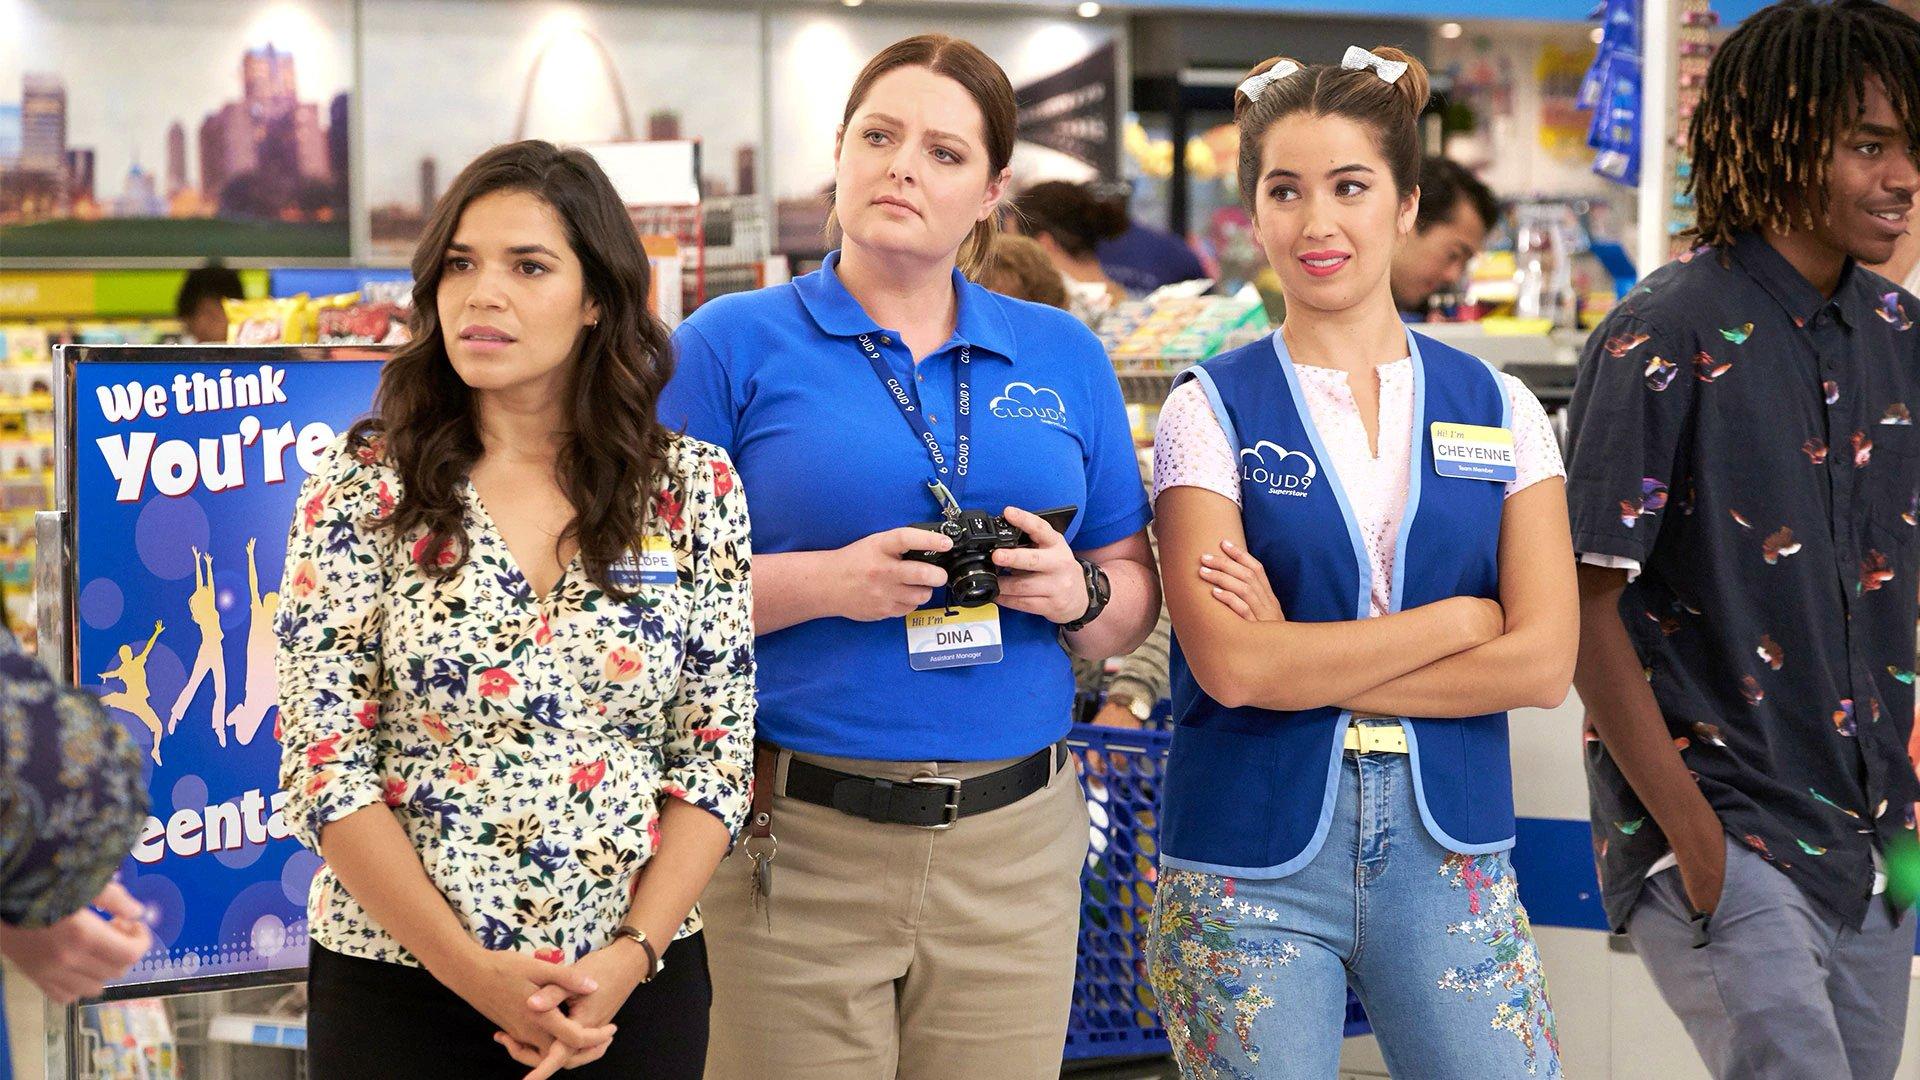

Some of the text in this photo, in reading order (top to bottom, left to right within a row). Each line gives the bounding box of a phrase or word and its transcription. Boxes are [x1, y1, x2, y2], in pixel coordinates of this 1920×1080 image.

[859, 334, 875, 352] OUD
[961, 347, 970, 364] CLO
[96, 365, 288, 423] We think
[887, 378, 910, 405] CLOUD
[959, 389, 970, 416] CLOUD
[1437, 430, 1465, 439] Hi! I'm
[96, 415, 337, 502] You're
[923, 432, 949, 474] CLOUD 9
[957, 443, 970, 476] CLOUD
[1438, 444, 1511, 462] CHEYENNE
[1242, 465, 1312, 490] LOUD9
[1473, 466, 1494, 474] Member
[1268, 487, 1308, 497] Superstore
[912, 616, 943, 627] Hi! I'm
[936, 629, 974, 645] DINA
[929, 651, 982, 662] Assistant Manager
[130, 789, 295, 864] eenta
